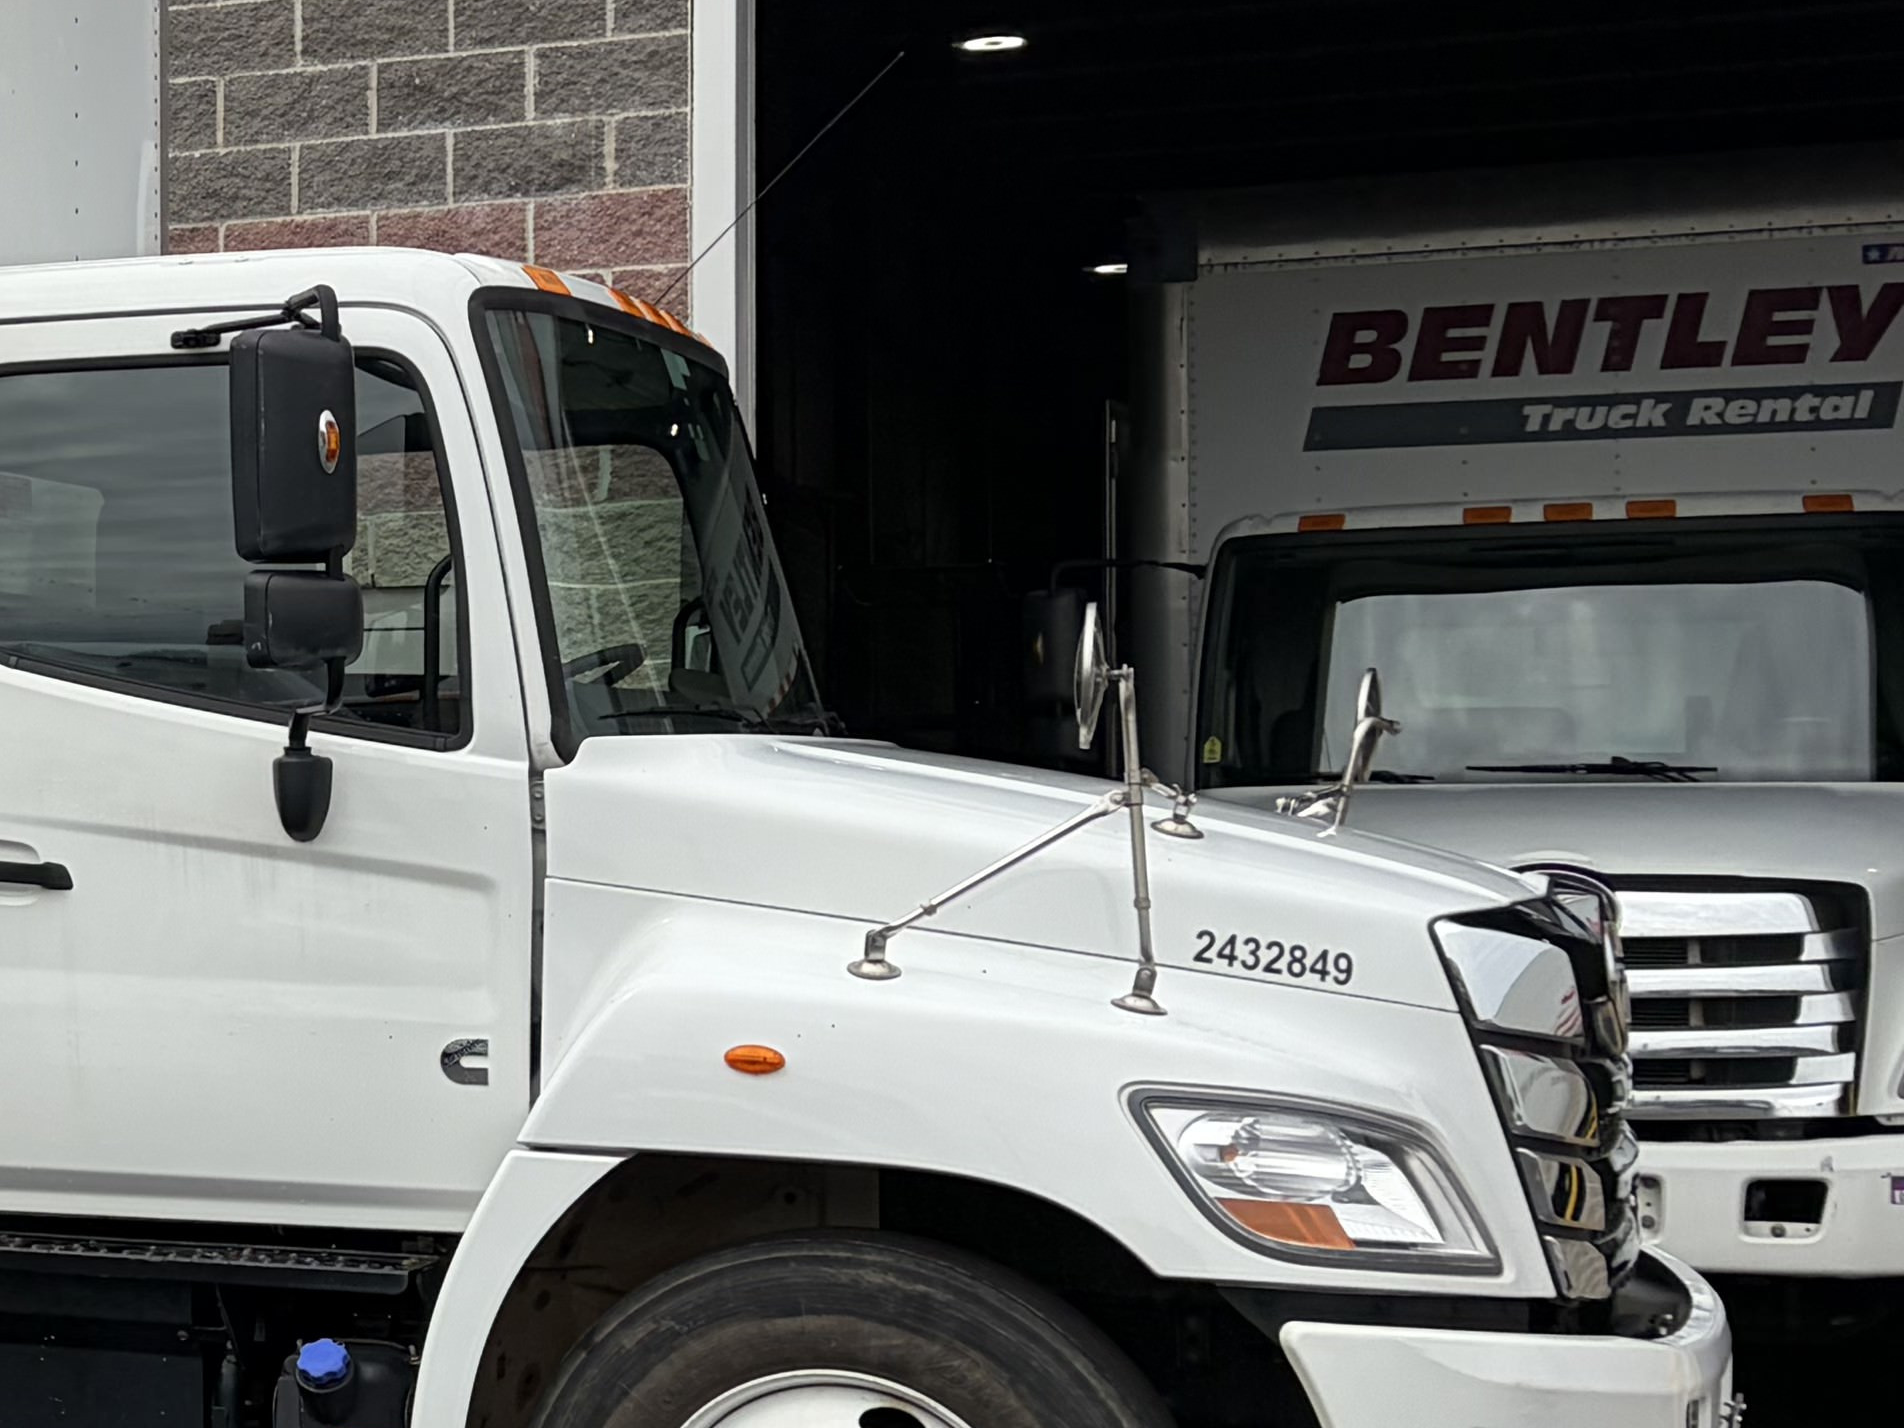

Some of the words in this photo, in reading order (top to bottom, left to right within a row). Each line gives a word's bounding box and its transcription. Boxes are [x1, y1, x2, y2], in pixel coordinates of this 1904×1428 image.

[1316, 283, 1904, 386] BENTLEY
[1522, 397, 1669, 433] Truck
[1686, 390, 1875, 426] Rental
[1193, 929, 1354, 986] 2432849
